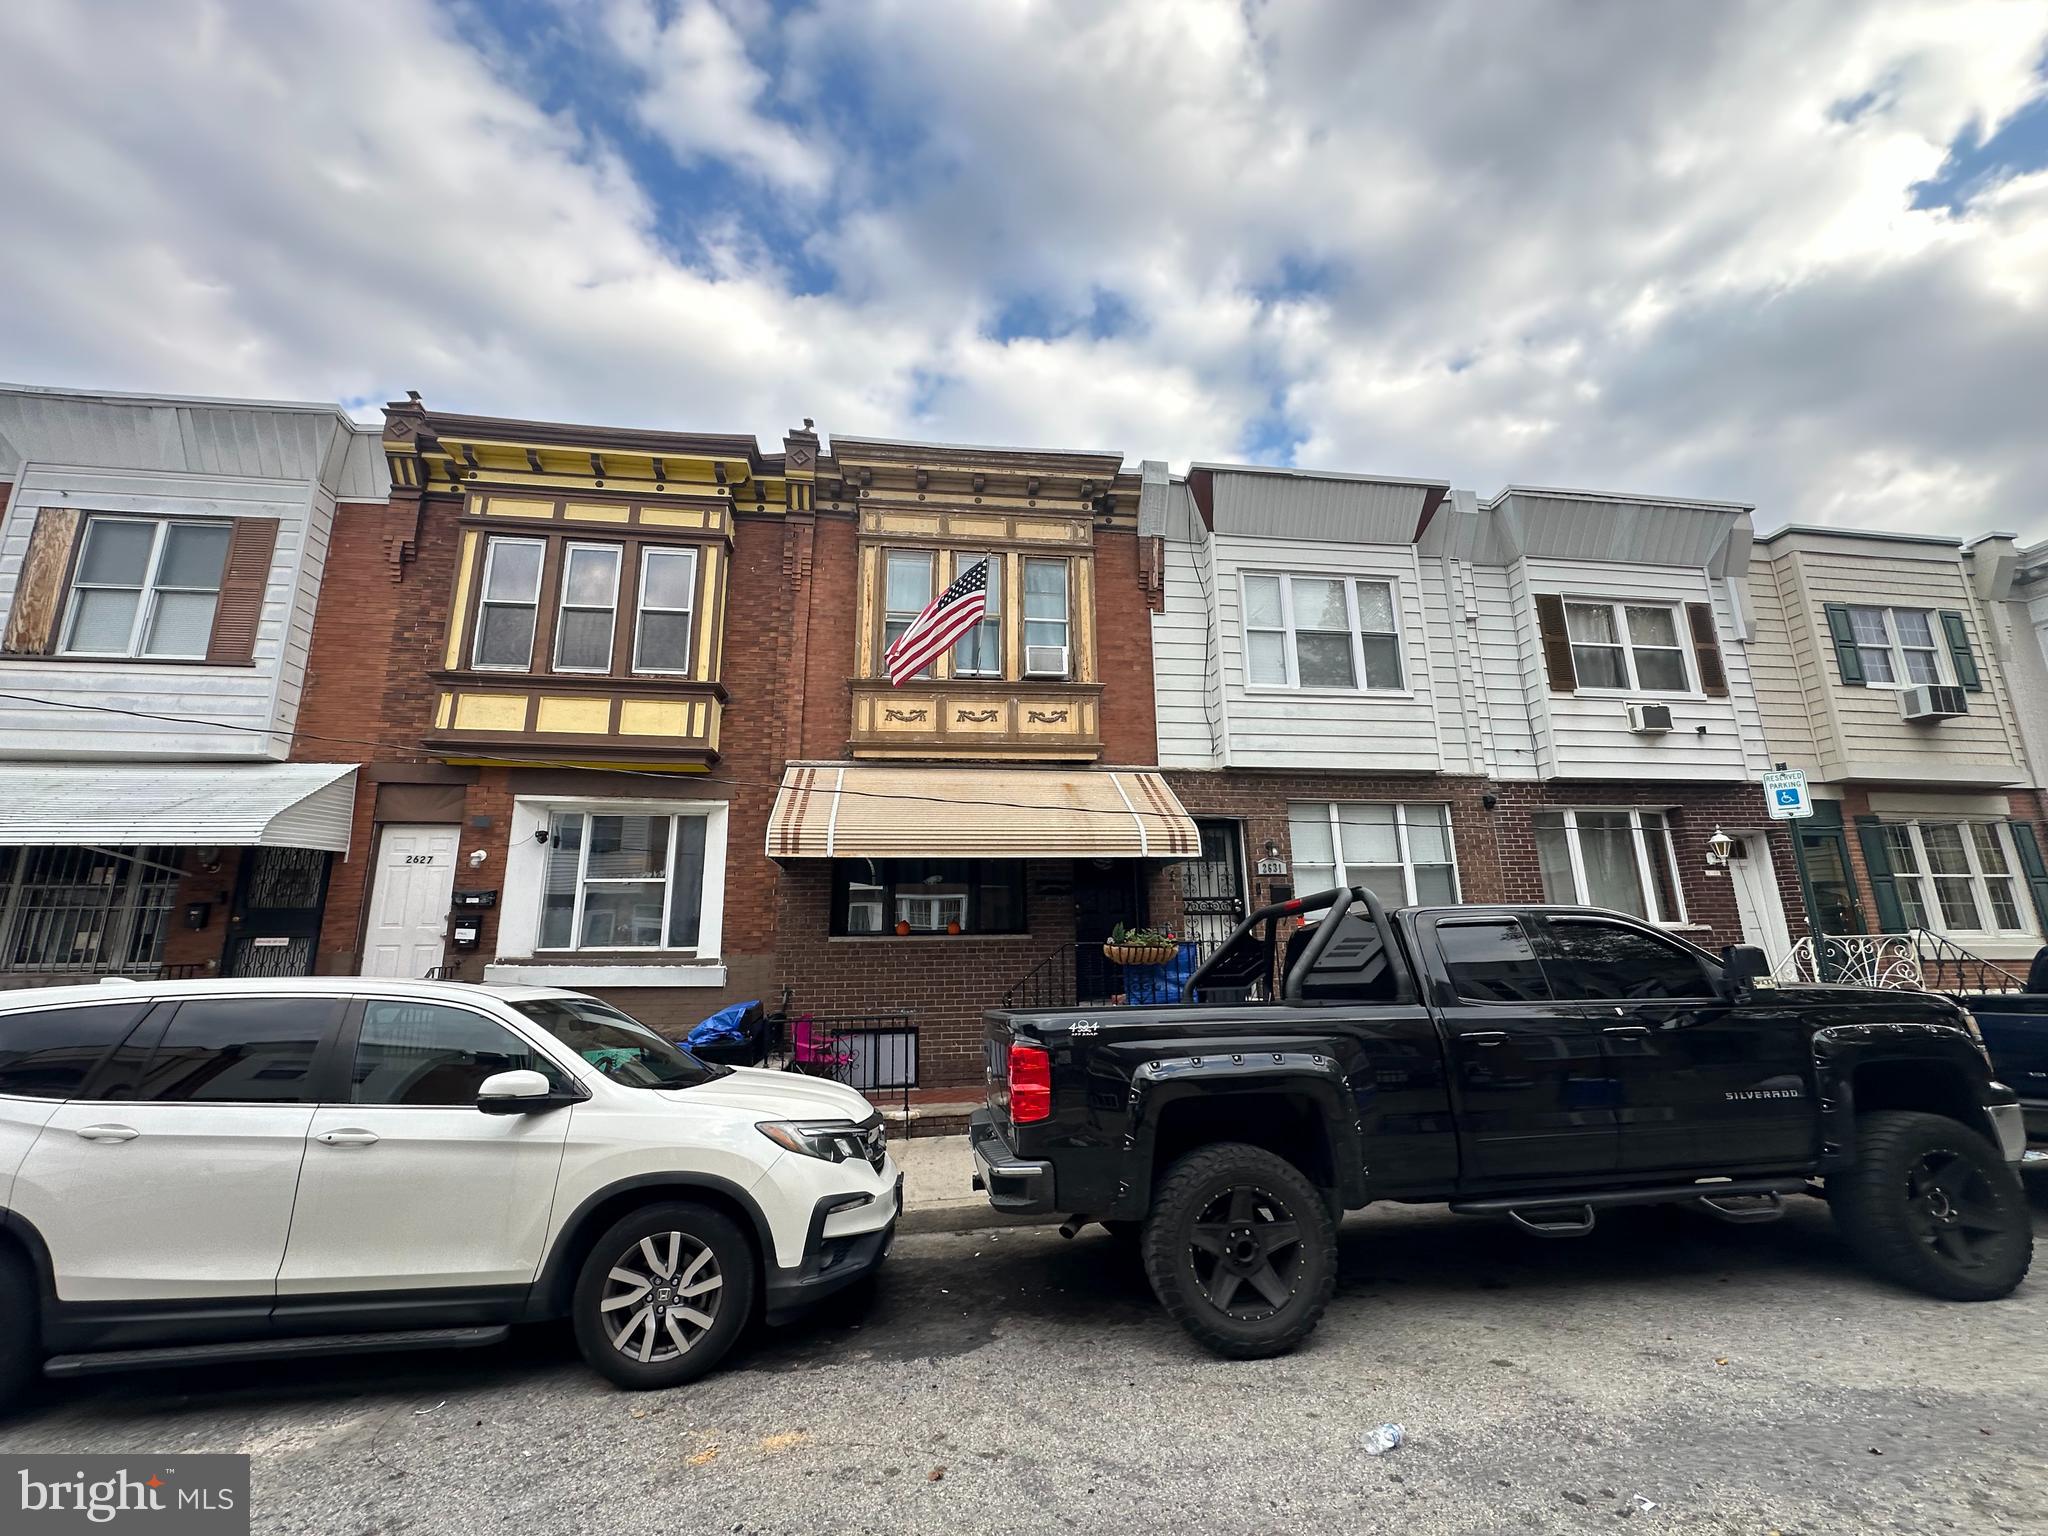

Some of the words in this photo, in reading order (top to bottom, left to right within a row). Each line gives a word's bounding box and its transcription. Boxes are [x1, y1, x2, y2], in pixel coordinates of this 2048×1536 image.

[1765, 772, 1802, 782] RESERVED
[1769, 780, 1802, 790] PARKING
[405, 855, 434, 865] 2627
[1261, 863, 1283, 874] 2631
[1724, 1089, 1799, 1100] SILVERADO
